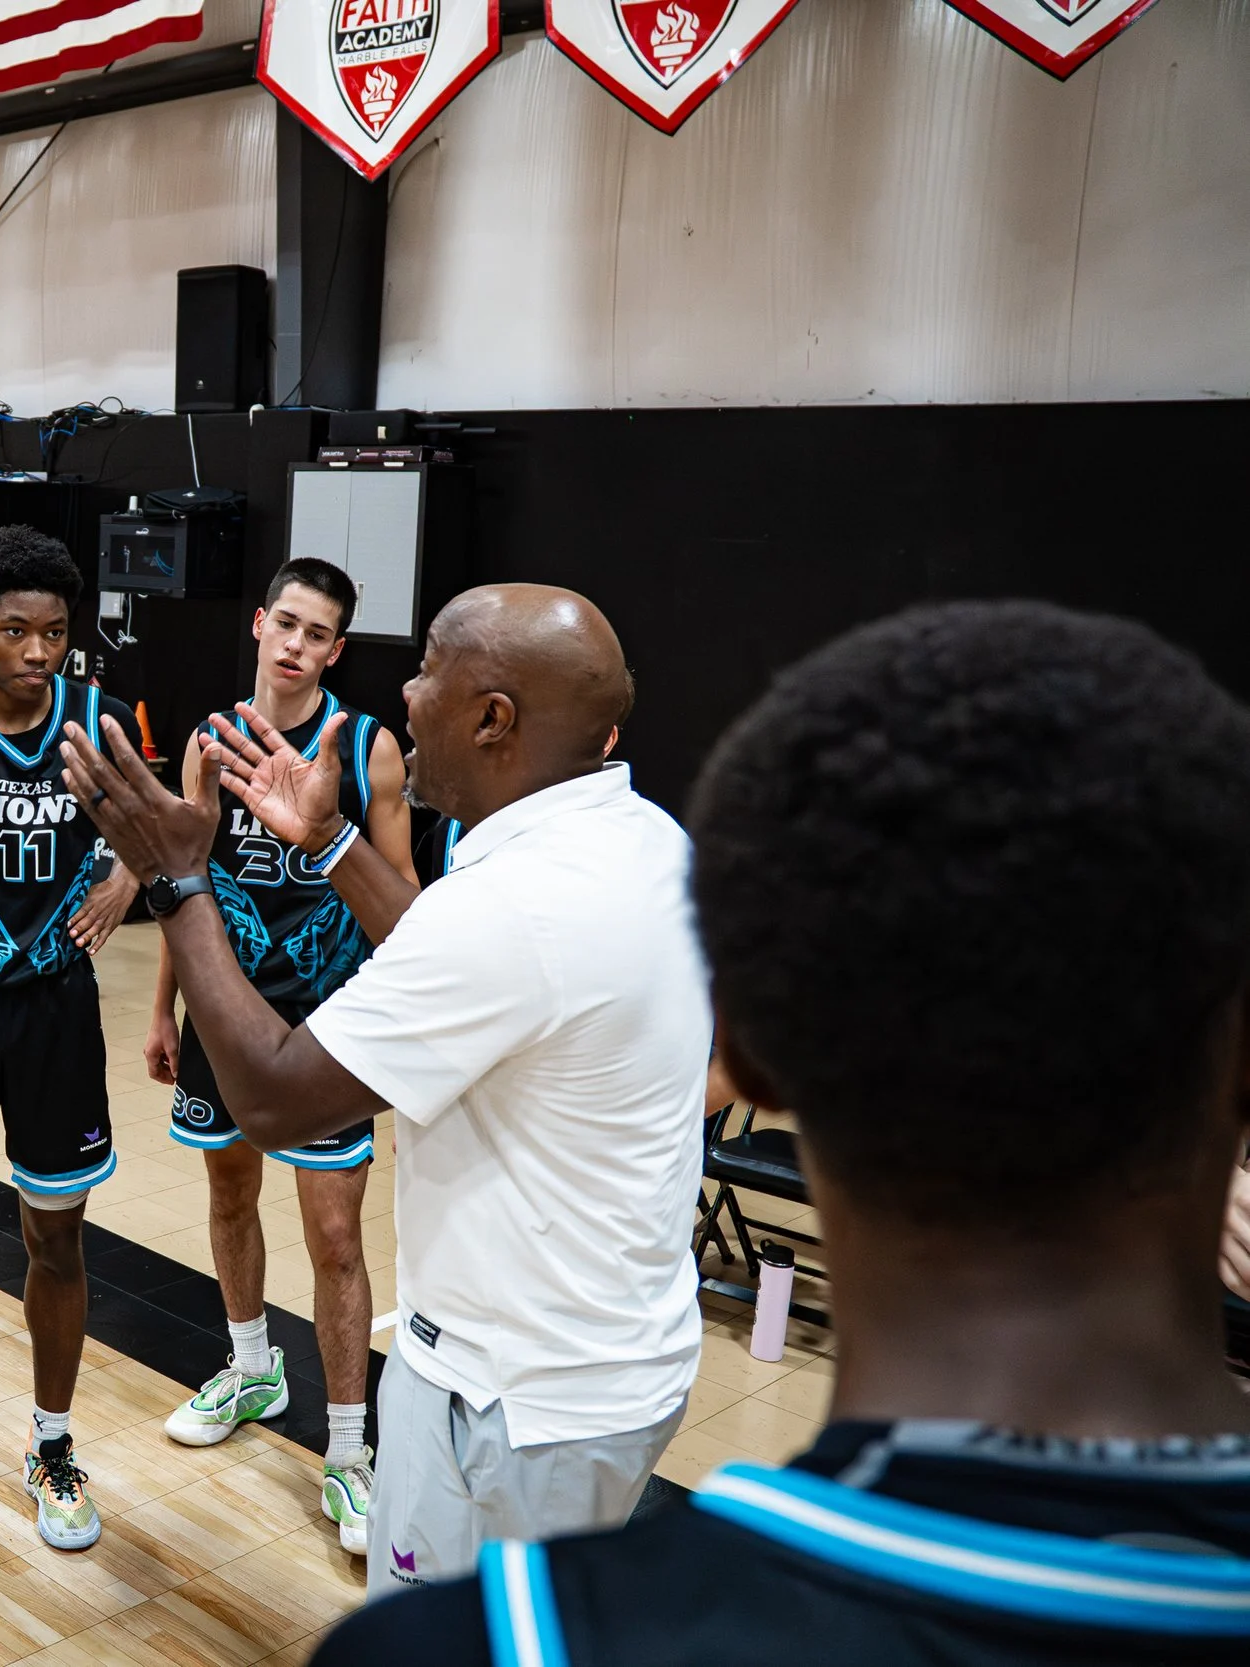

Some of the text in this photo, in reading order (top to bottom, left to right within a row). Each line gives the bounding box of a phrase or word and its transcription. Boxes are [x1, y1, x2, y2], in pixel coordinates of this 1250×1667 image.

[339, 17, 428, 52] ACADEMY
[337, 41, 428, 64] MARBLE FALLS
[0, 778, 52, 795] TEXAS
[172, 1084, 215, 1128] 30
[80, 1136, 107, 1152] MONARCH
[389, 1566, 427, 1586] MONARC
